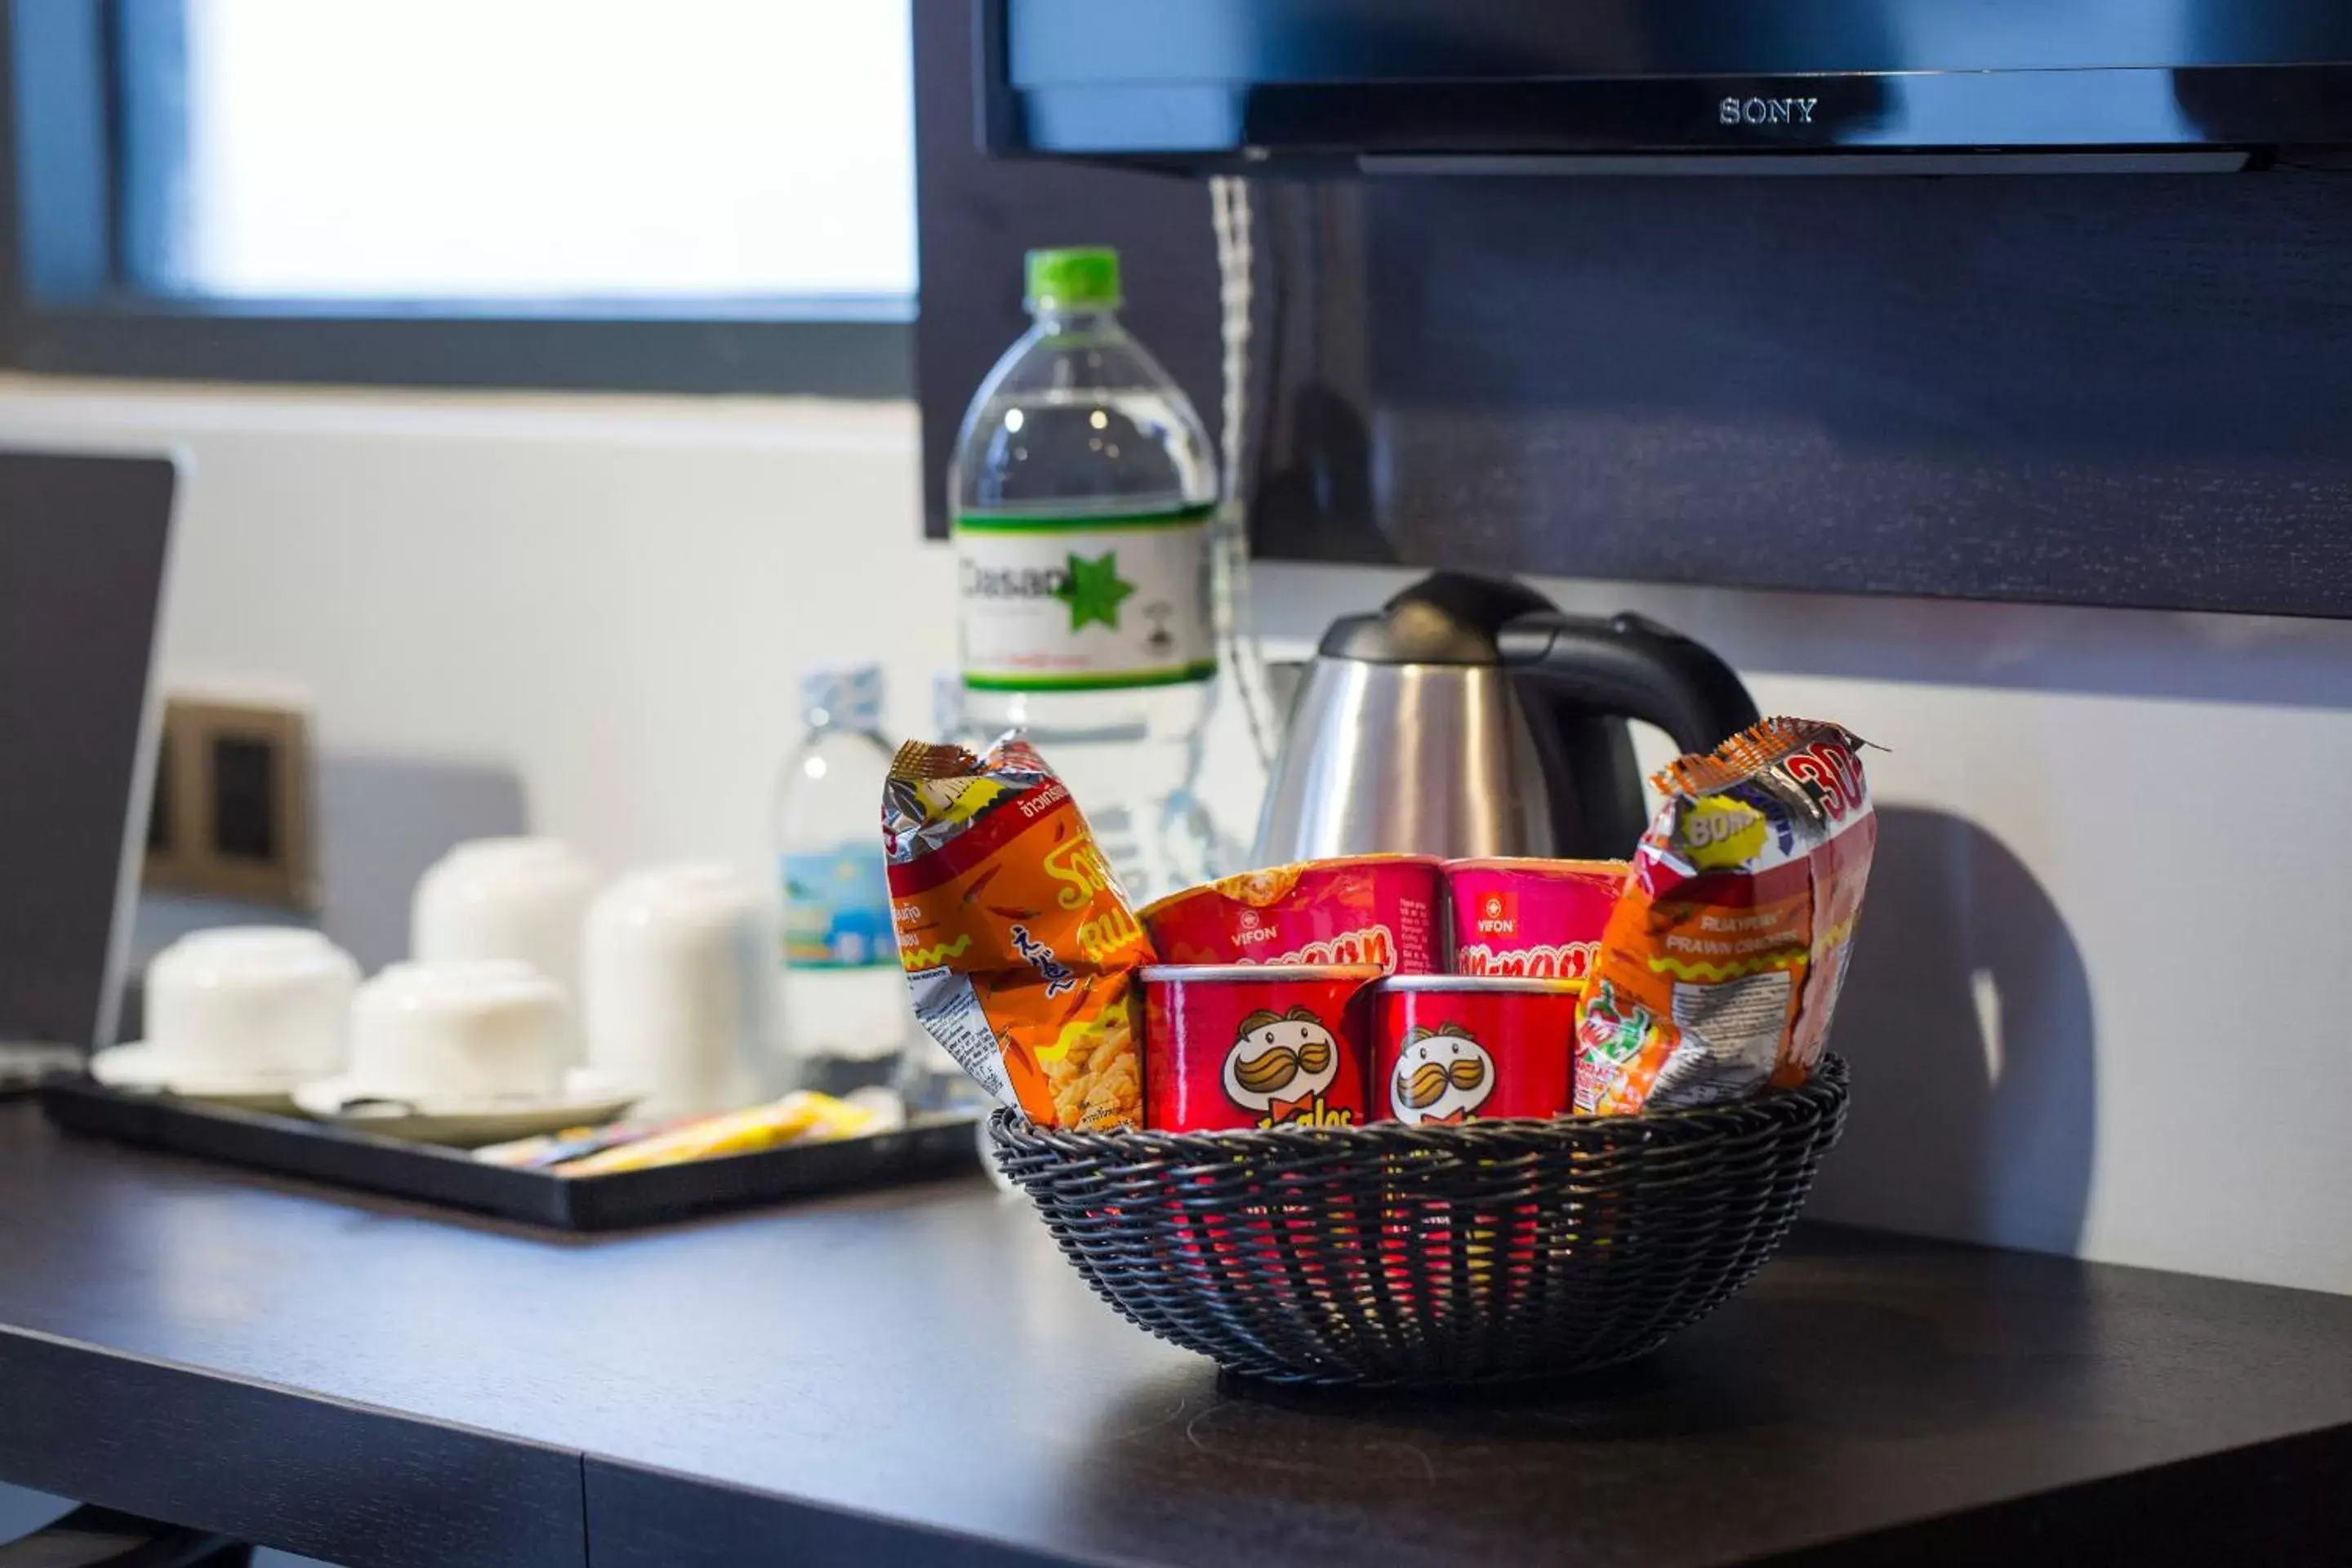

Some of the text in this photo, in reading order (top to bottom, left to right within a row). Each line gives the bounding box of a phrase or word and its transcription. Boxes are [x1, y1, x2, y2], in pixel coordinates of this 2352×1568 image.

[1719, 96, 1818, 124] SONY
[1231, 924, 1277, 947] VIFON
[1477, 919, 1514, 933] VIFON
